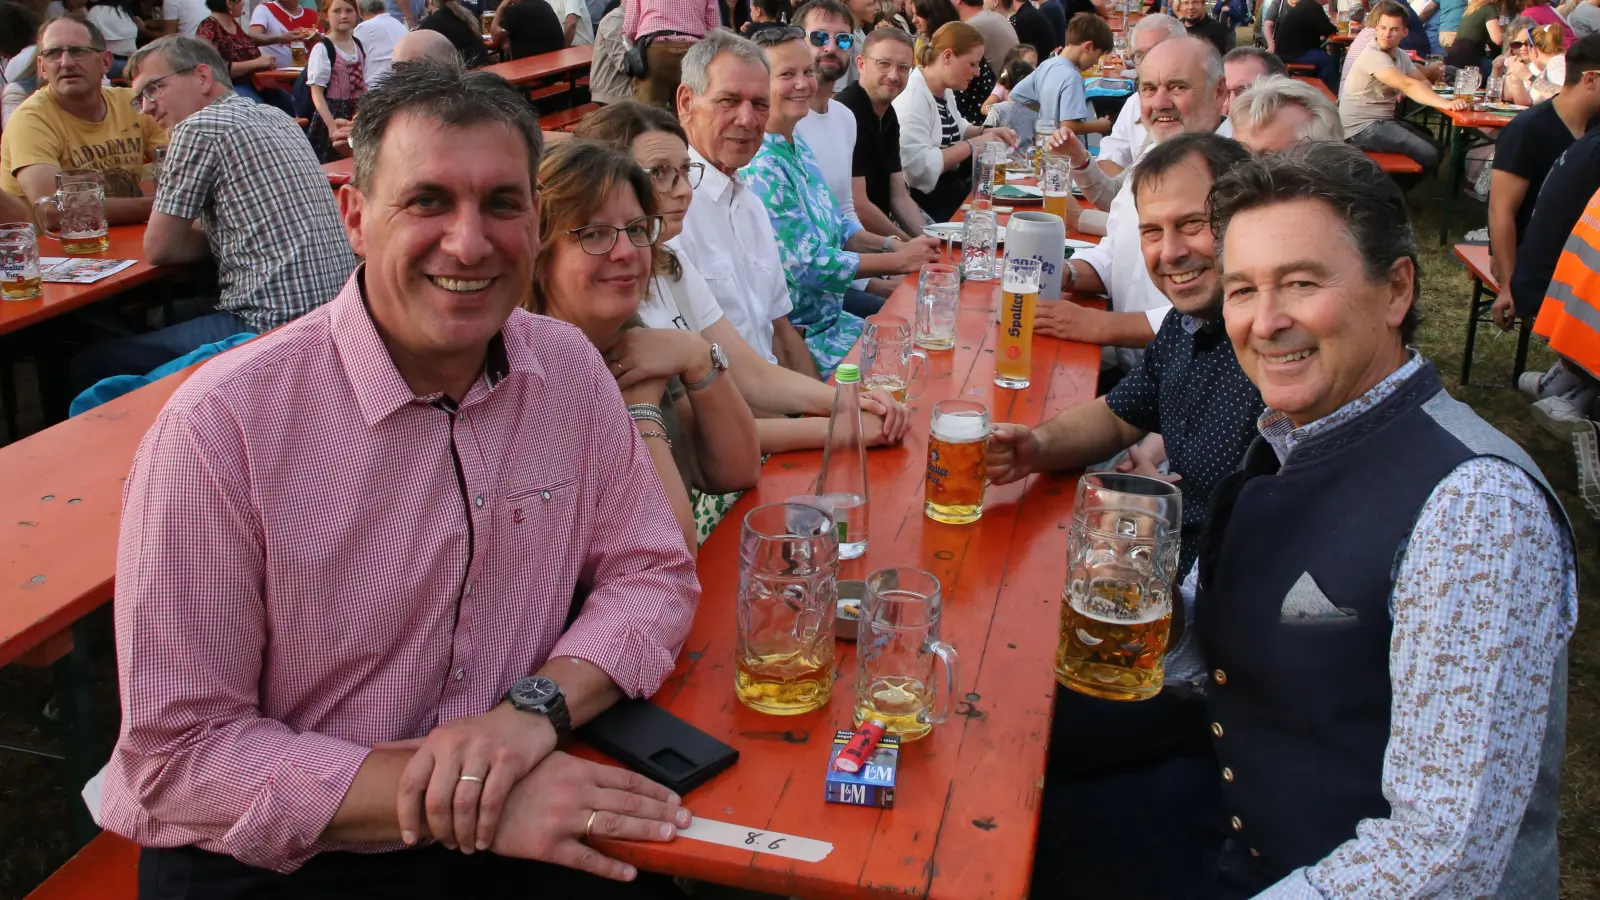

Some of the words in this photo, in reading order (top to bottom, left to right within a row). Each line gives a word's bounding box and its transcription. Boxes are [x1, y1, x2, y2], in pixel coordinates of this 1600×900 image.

[1008, 293, 1024, 338] Spalter
[864, 764, 893, 782] L&M
[840, 782, 866, 805] L&M
